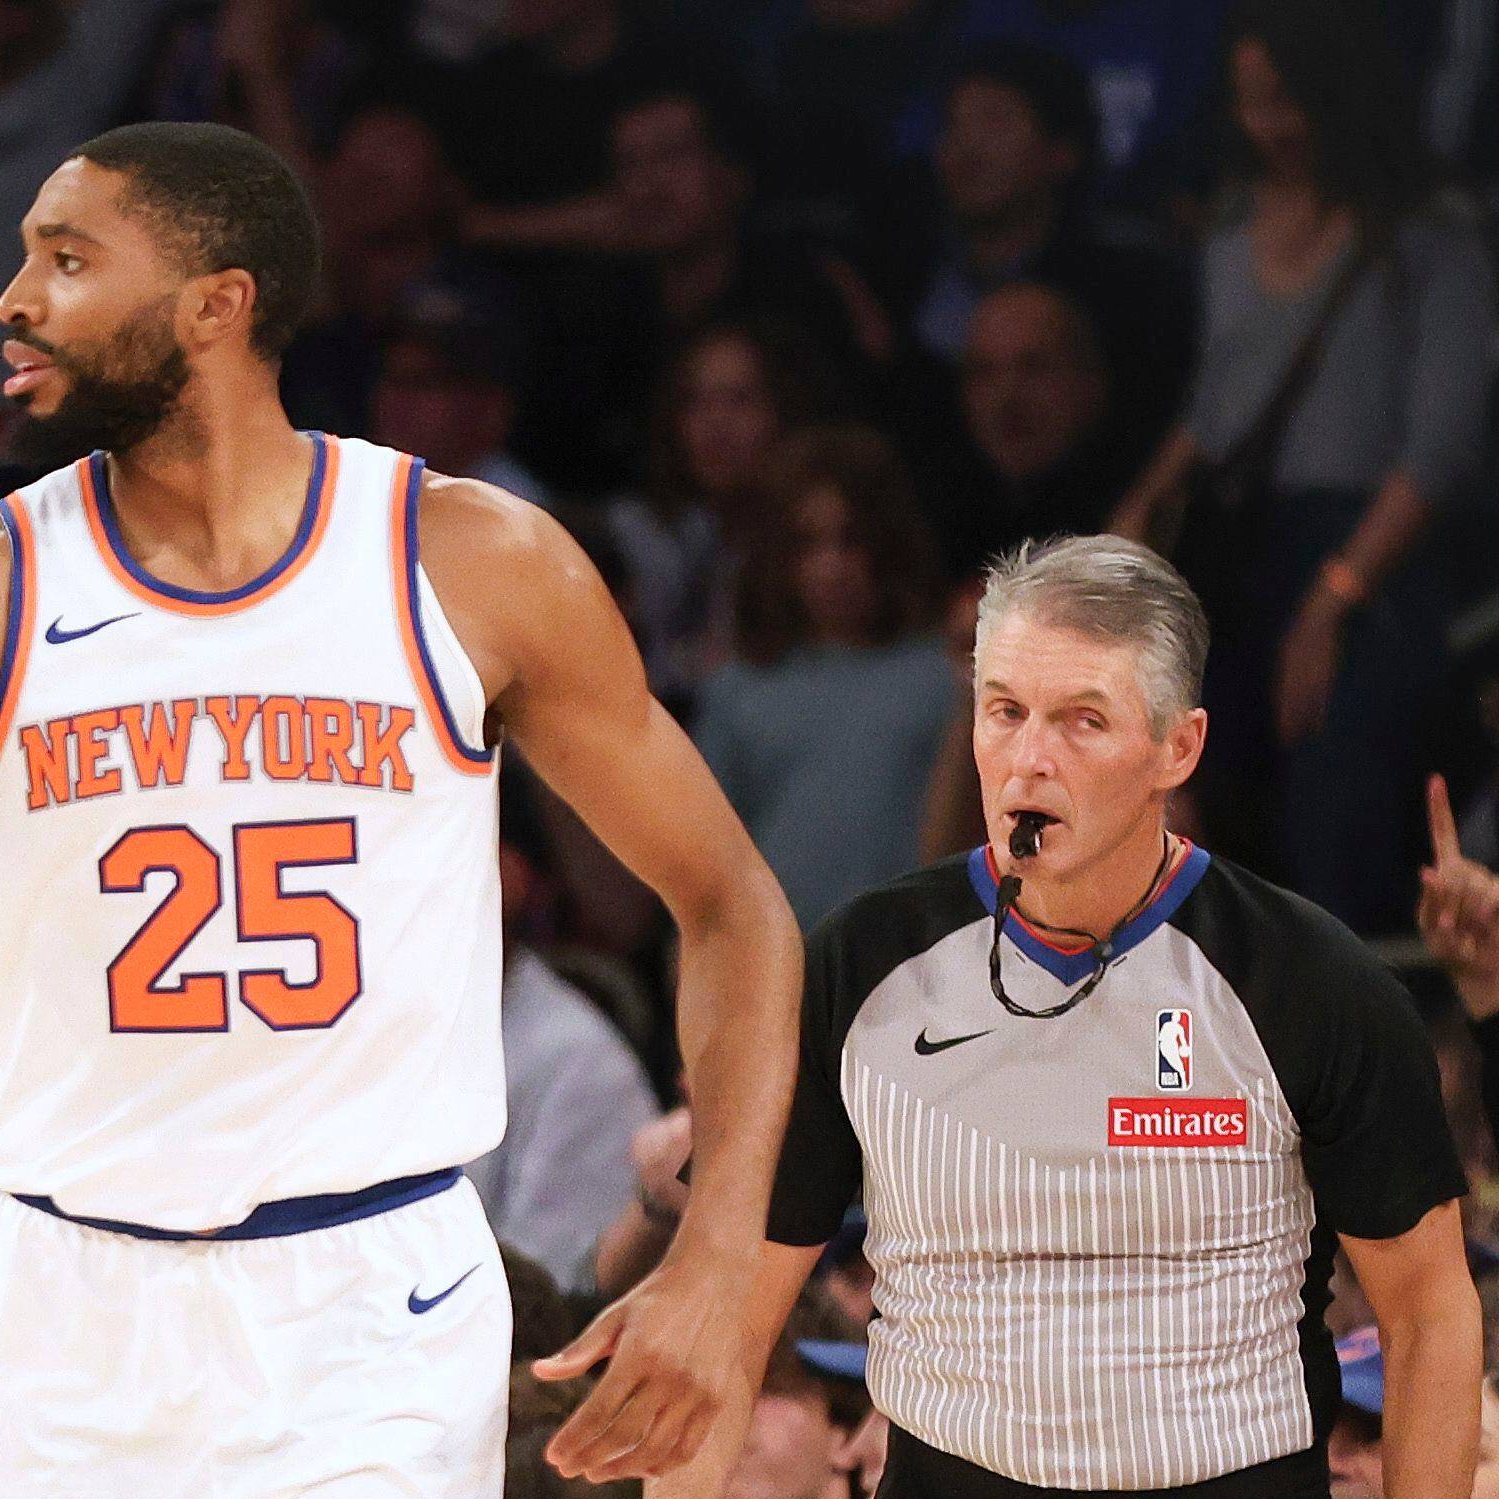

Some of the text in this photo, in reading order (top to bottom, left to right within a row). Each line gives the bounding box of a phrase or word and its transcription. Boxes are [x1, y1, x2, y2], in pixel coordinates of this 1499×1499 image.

[18, 694, 415, 812] NEW YORK
[98, 815, 364, 1034] 25
[1112, 1107, 1245, 1137] Emirates
